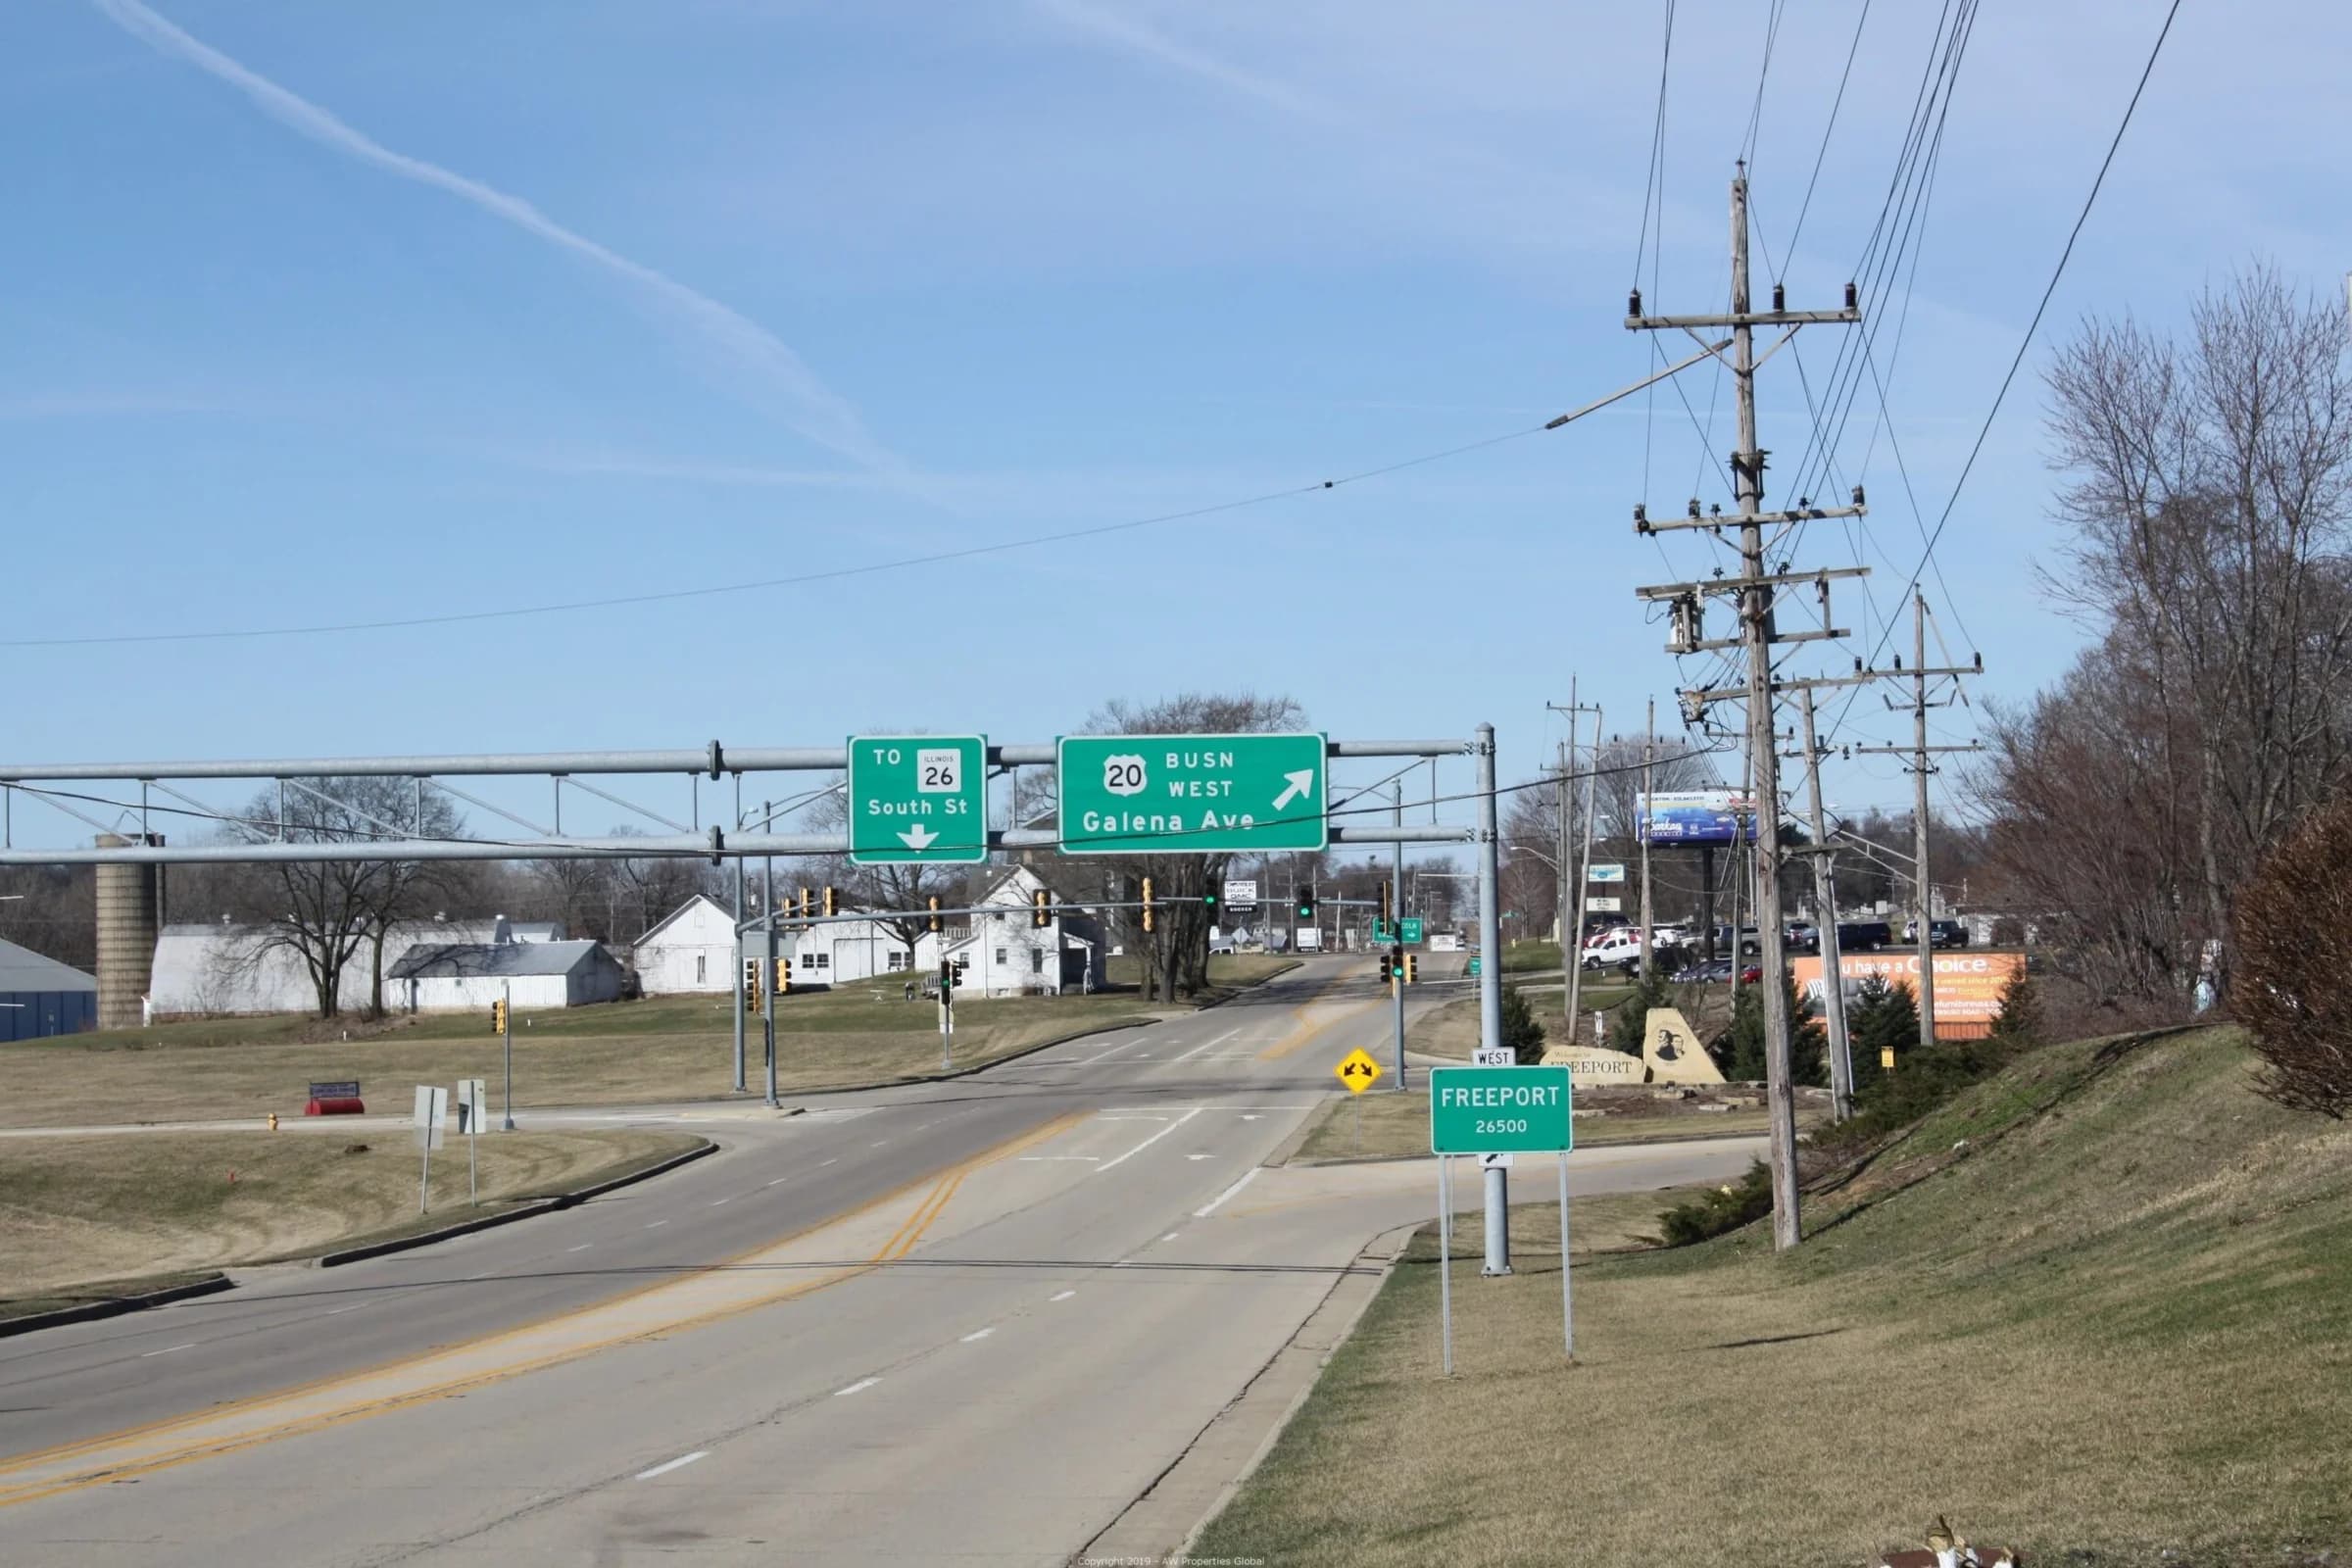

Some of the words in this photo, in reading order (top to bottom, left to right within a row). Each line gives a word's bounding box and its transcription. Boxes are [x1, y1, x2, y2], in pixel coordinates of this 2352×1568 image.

[872, 749, 901, 765] TO
[923, 755, 955, 763] ILLINOIS
[1165, 752, 1234, 769] BUSN
[924, 767, 954, 787] 26
[1107, 763, 1143, 788] 20
[1168, 780, 1233, 799] WEST
[868, 798, 933, 815] South
[944, 797, 968, 814] St
[1082, 810, 1183, 833] Galena
[1200, 810, 1254, 831] Ave
[1855, 958, 1890, 973] have
[1894, 961, 1903, 973] a
[1478, 1052, 1510, 1065] WEST
[1441, 1086, 1560, 1107] FREEPORT
[1475, 1118, 1528, 1134] 26500
